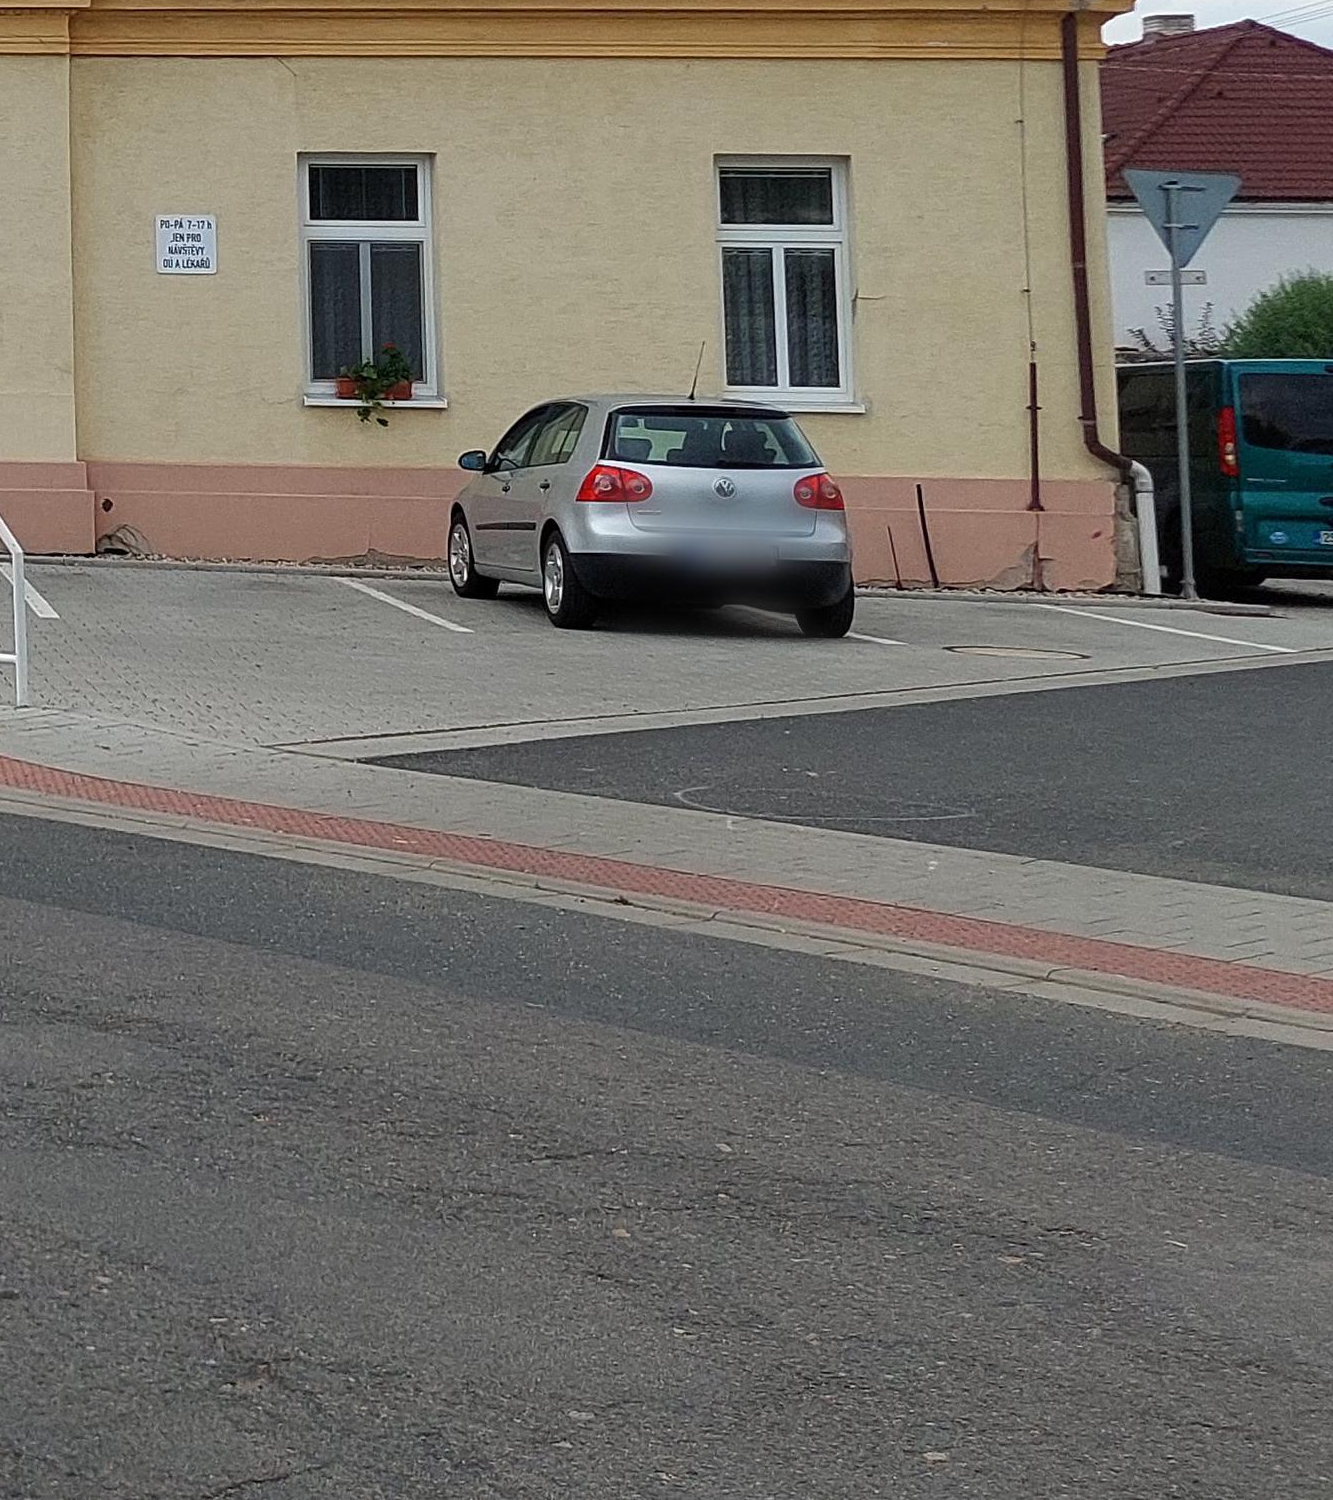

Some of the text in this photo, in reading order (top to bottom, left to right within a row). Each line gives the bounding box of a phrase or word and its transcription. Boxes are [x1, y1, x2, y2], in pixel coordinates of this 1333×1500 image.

[160, 218, 183, 229] PO-PÁ
[207, 220, 212, 229] h
[170, 233, 202, 243] JEN PRO
[168, 244, 205, 256] NÁVŠTĚVY
[175, 258, 180, 268] A
[182, 257, 210, 269] LÉKAŘŮ
